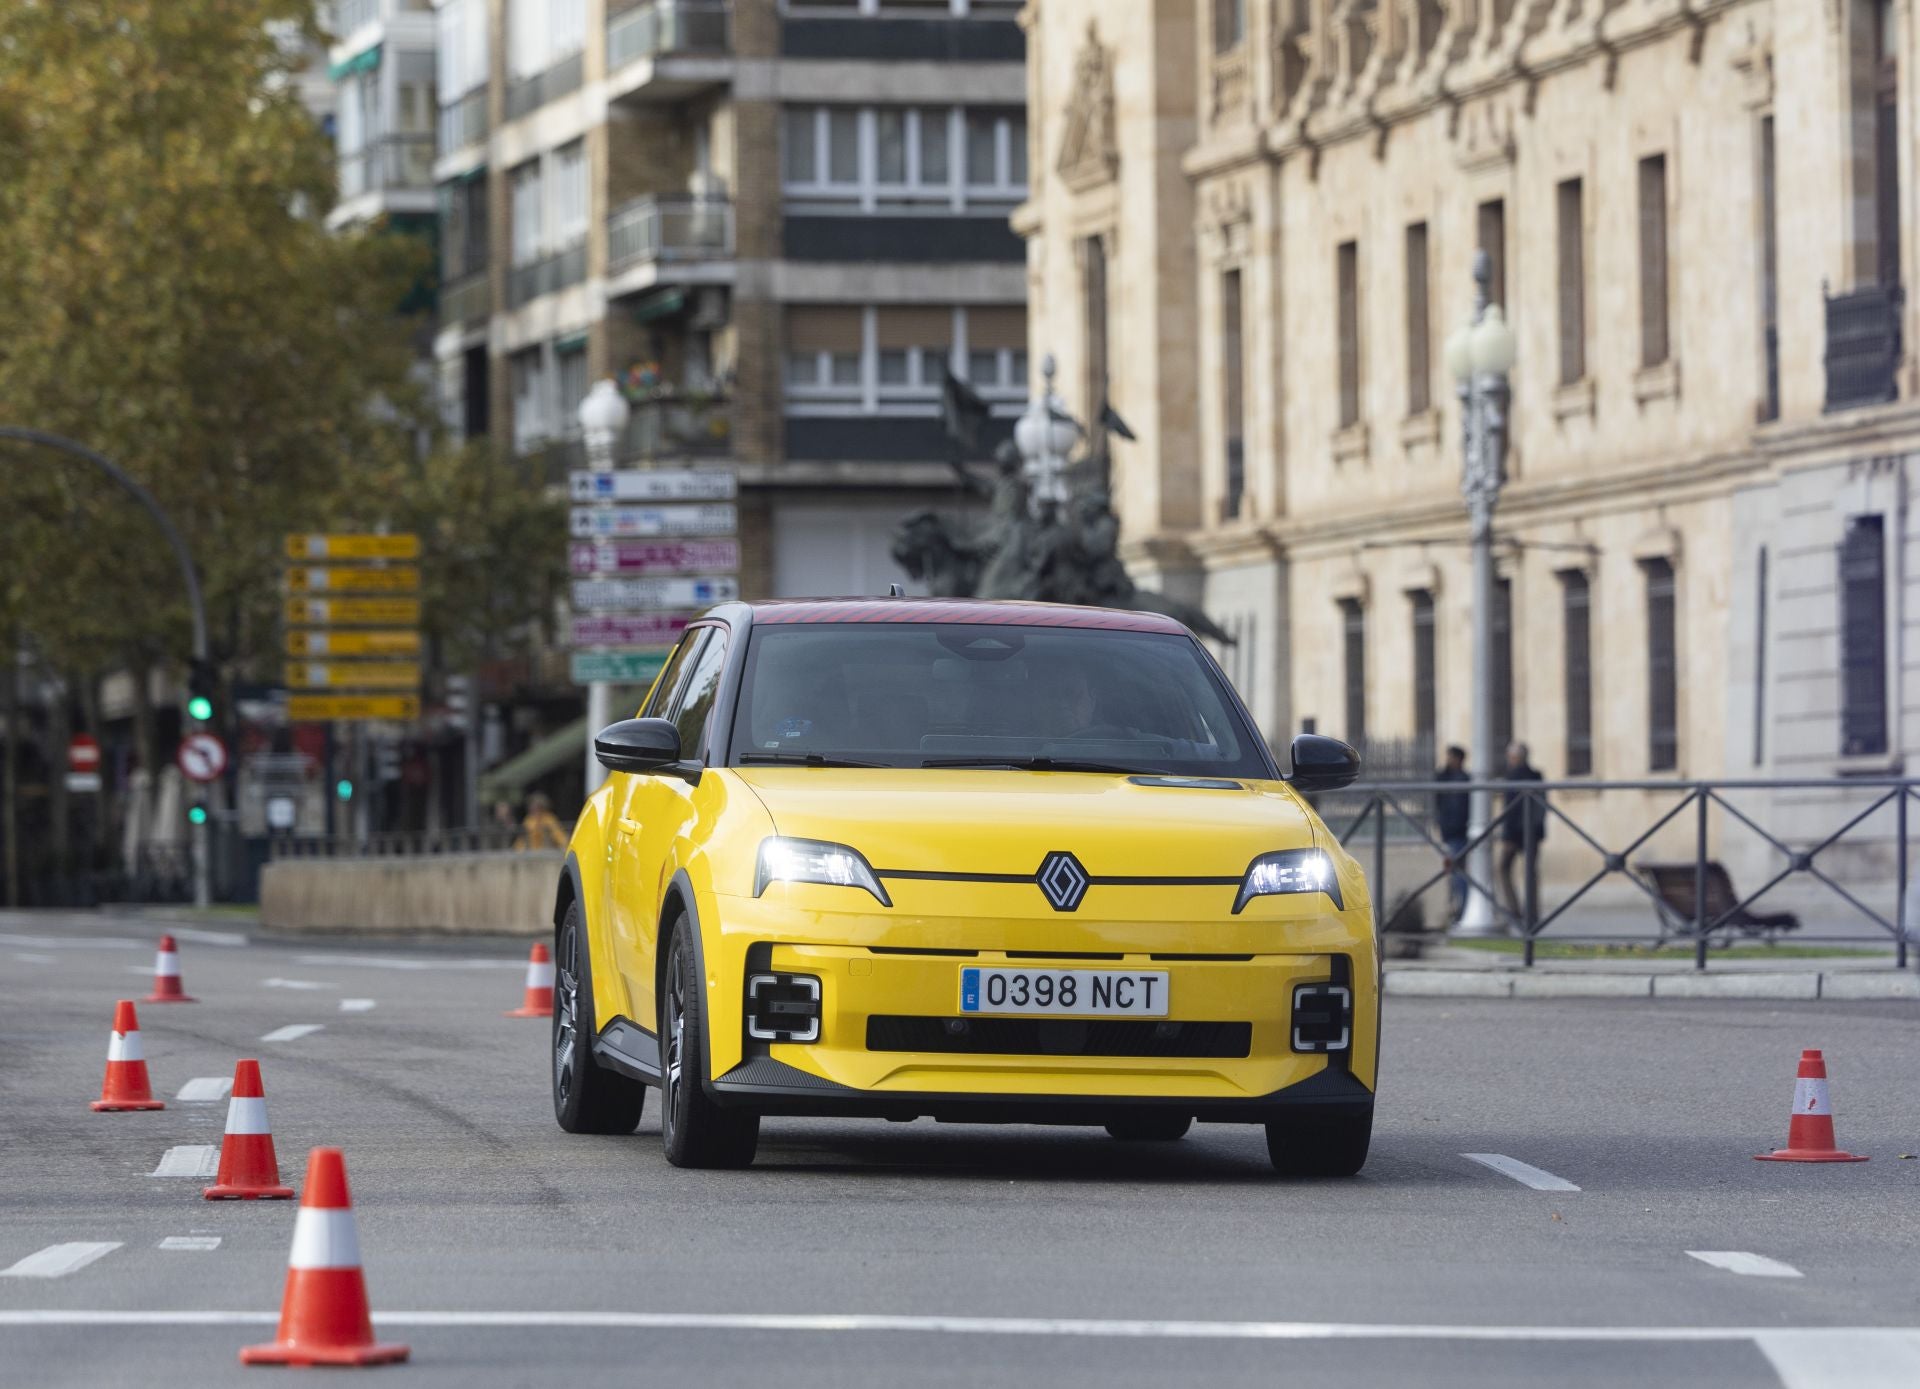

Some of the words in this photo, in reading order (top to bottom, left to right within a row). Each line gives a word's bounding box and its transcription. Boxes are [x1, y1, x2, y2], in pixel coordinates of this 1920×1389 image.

[967, 993, 975, 1004] E
[987, 973, 1077, 1008] 0398
[1092, 975, 1158, 1009] NCT
